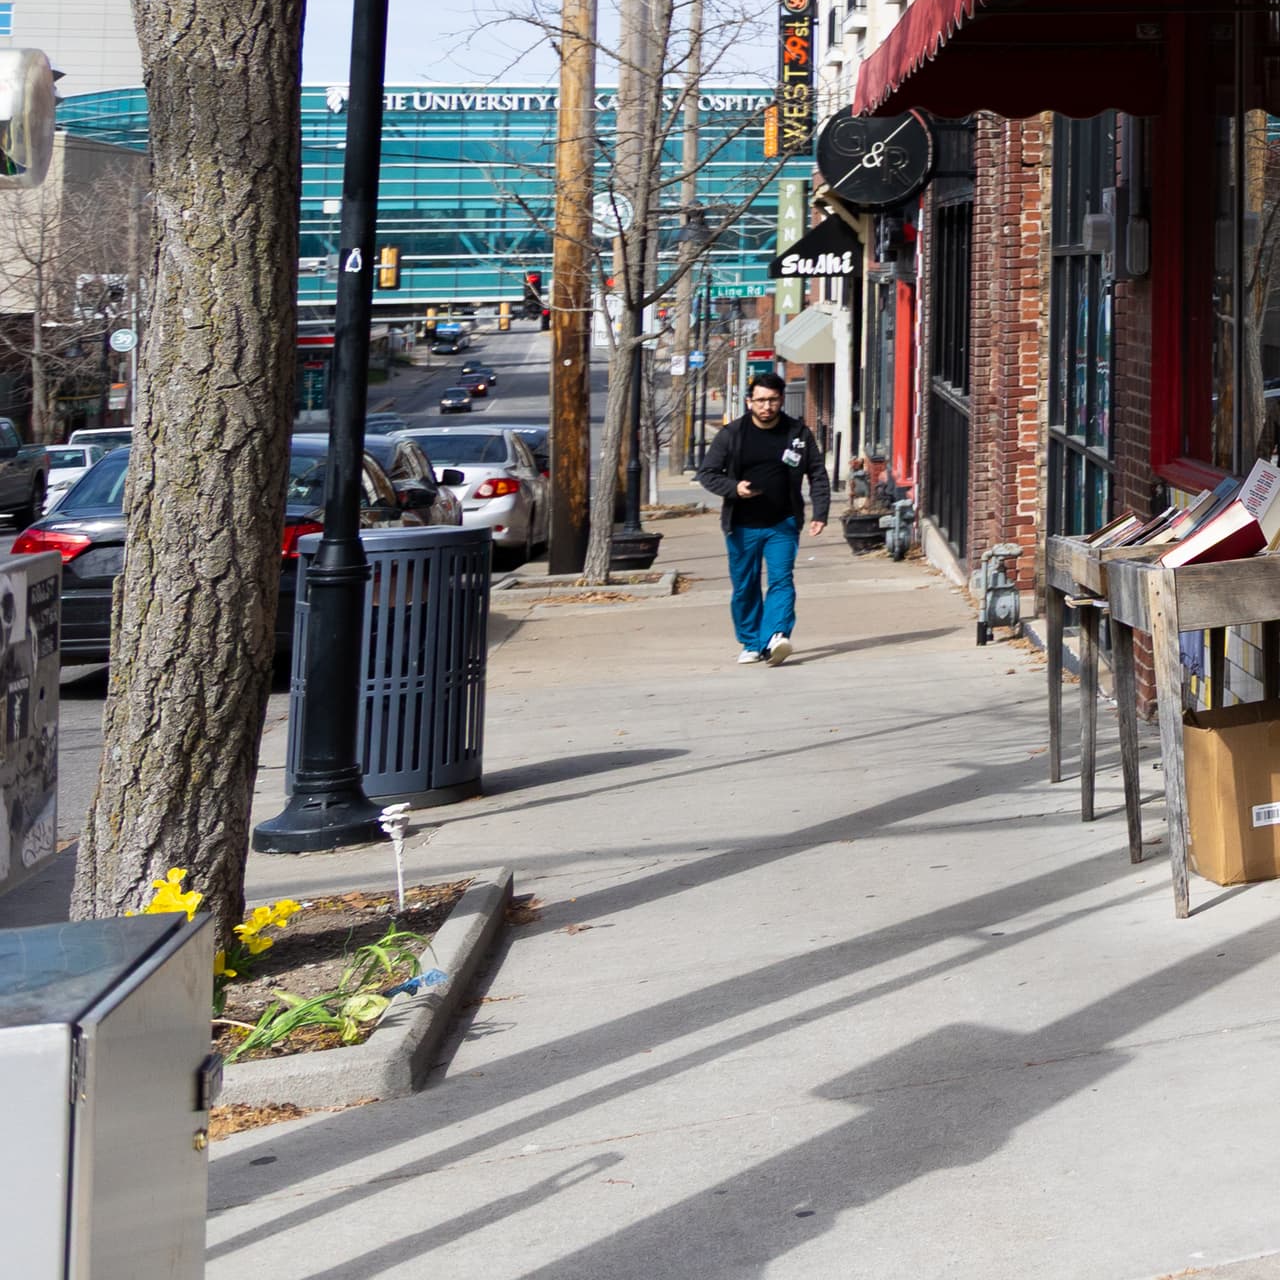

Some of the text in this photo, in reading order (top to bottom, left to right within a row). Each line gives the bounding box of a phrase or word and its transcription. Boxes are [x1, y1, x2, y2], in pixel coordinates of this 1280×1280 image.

[412, 91, 552, 111] UNIVERSITY
[830, 116, 912, 187] G & R
[781, 183, 797, 309] PANRA
[747, 286, 762, 297] Rd
[116, 333, 133, 345] 39
